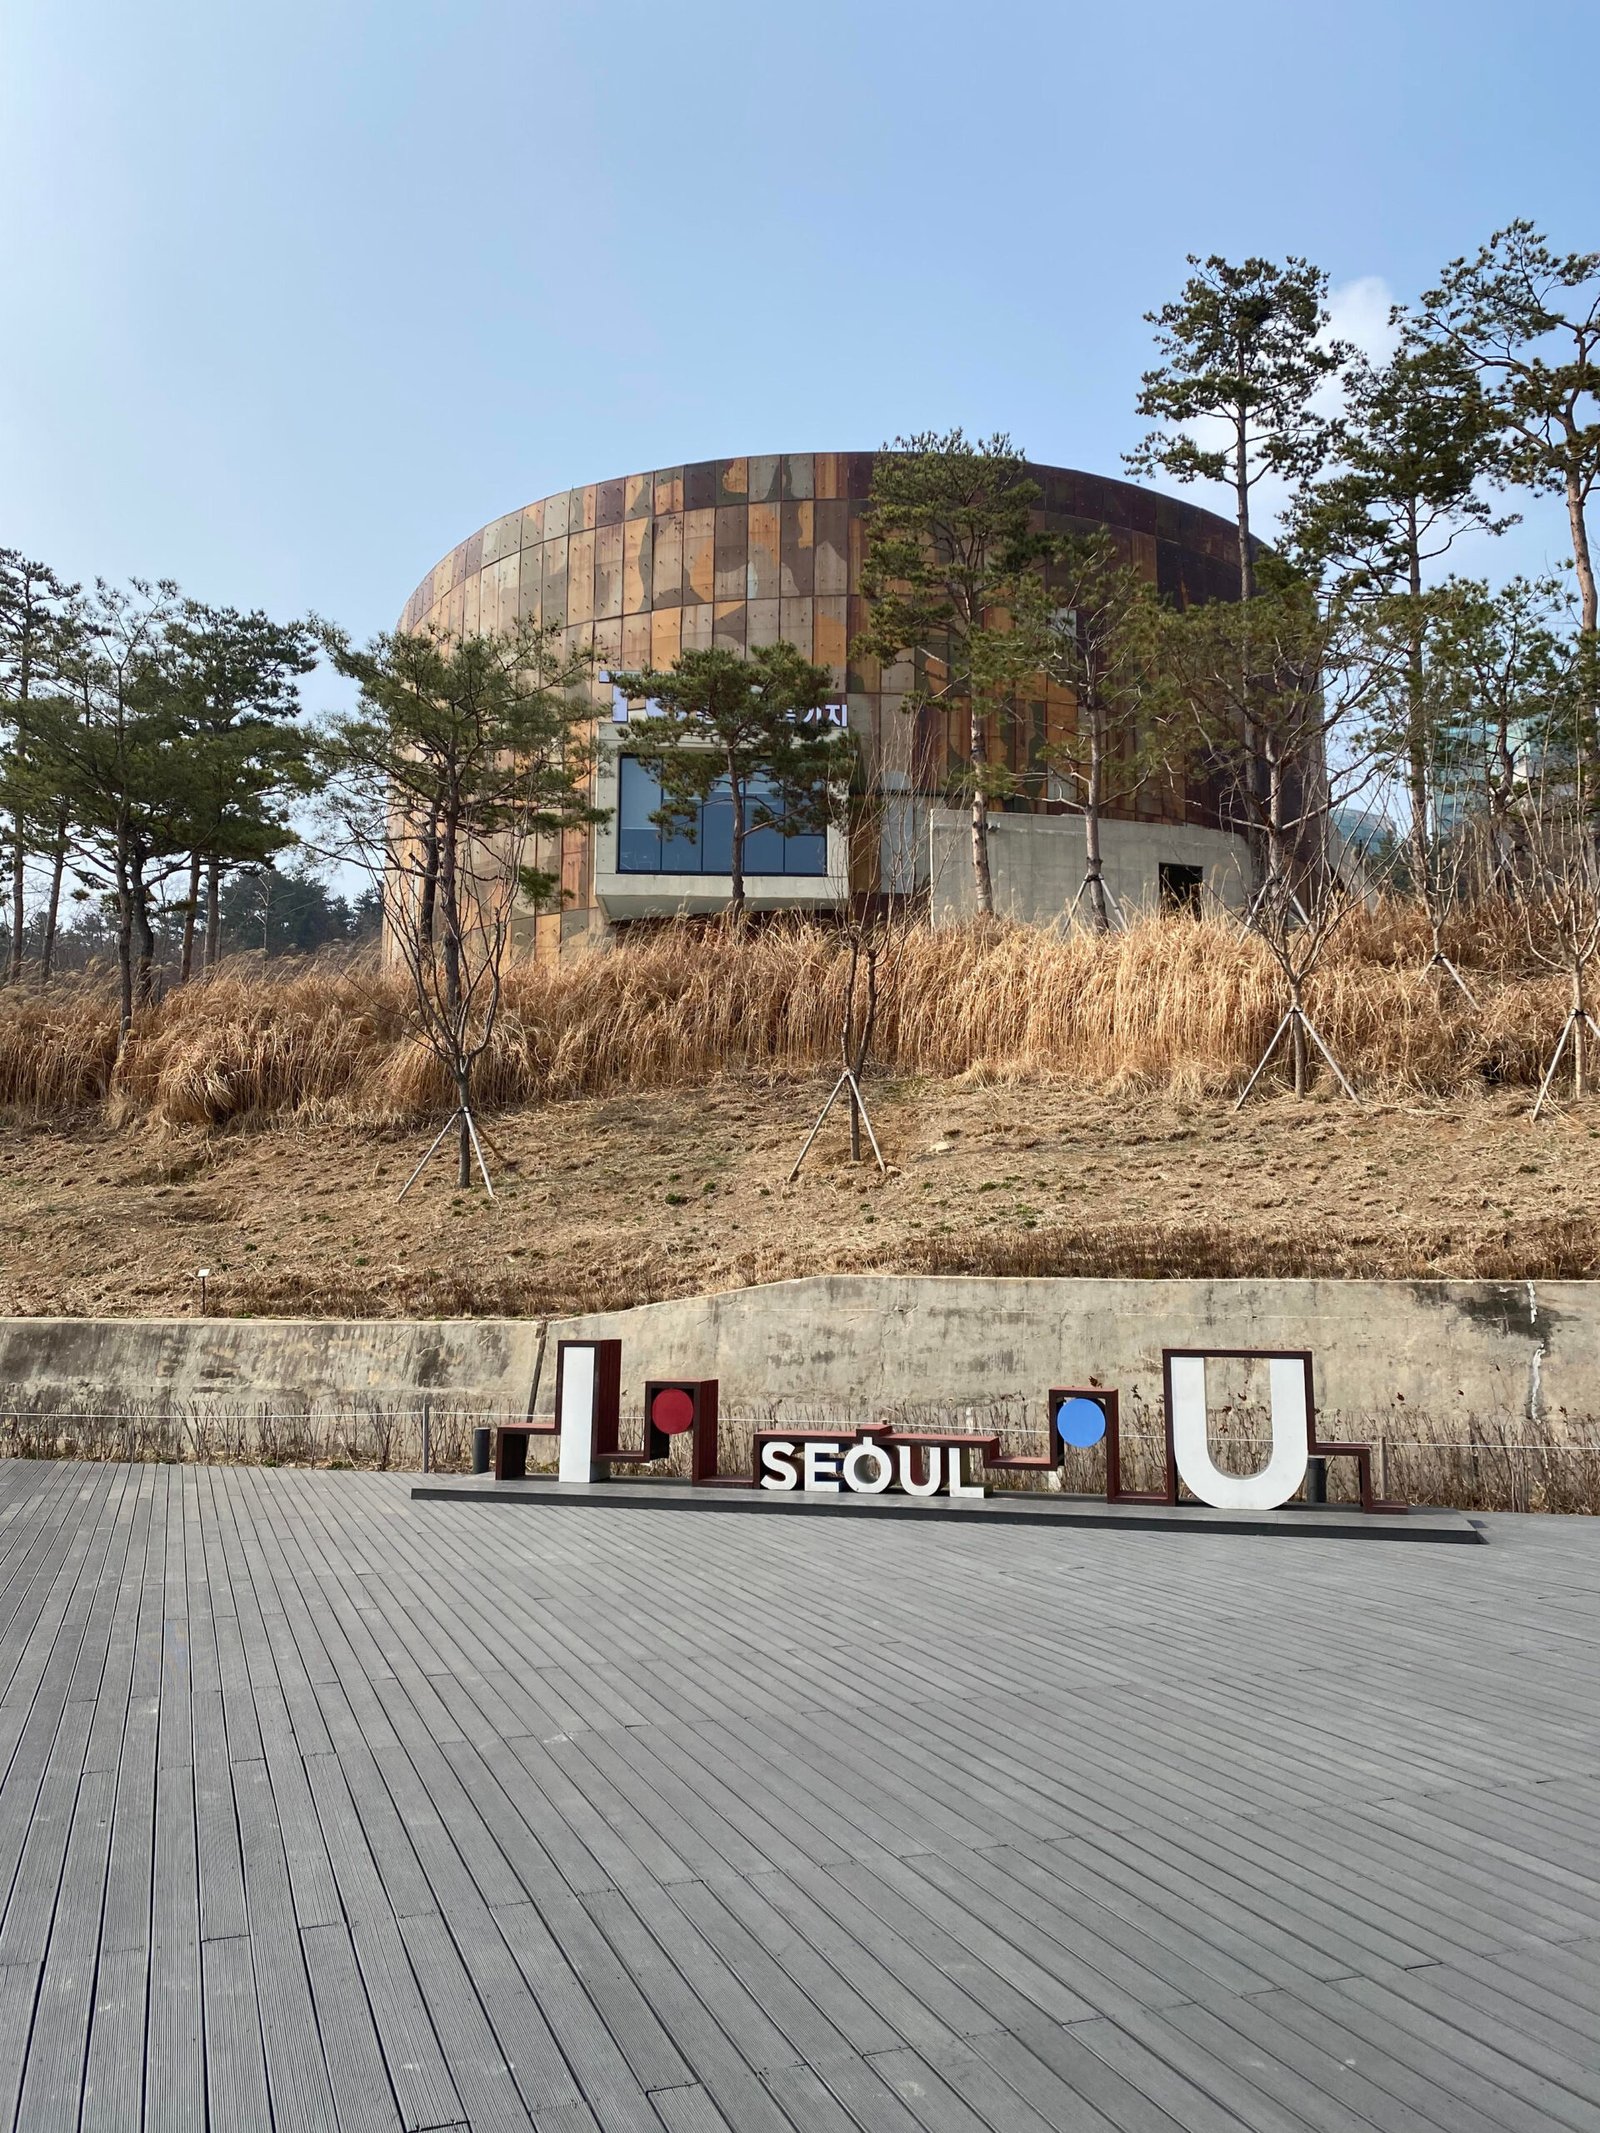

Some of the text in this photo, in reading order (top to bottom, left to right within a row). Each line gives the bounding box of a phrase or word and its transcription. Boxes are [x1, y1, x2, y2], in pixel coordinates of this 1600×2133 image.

[559, 1347, 1309, 1511] I SEOUL U
